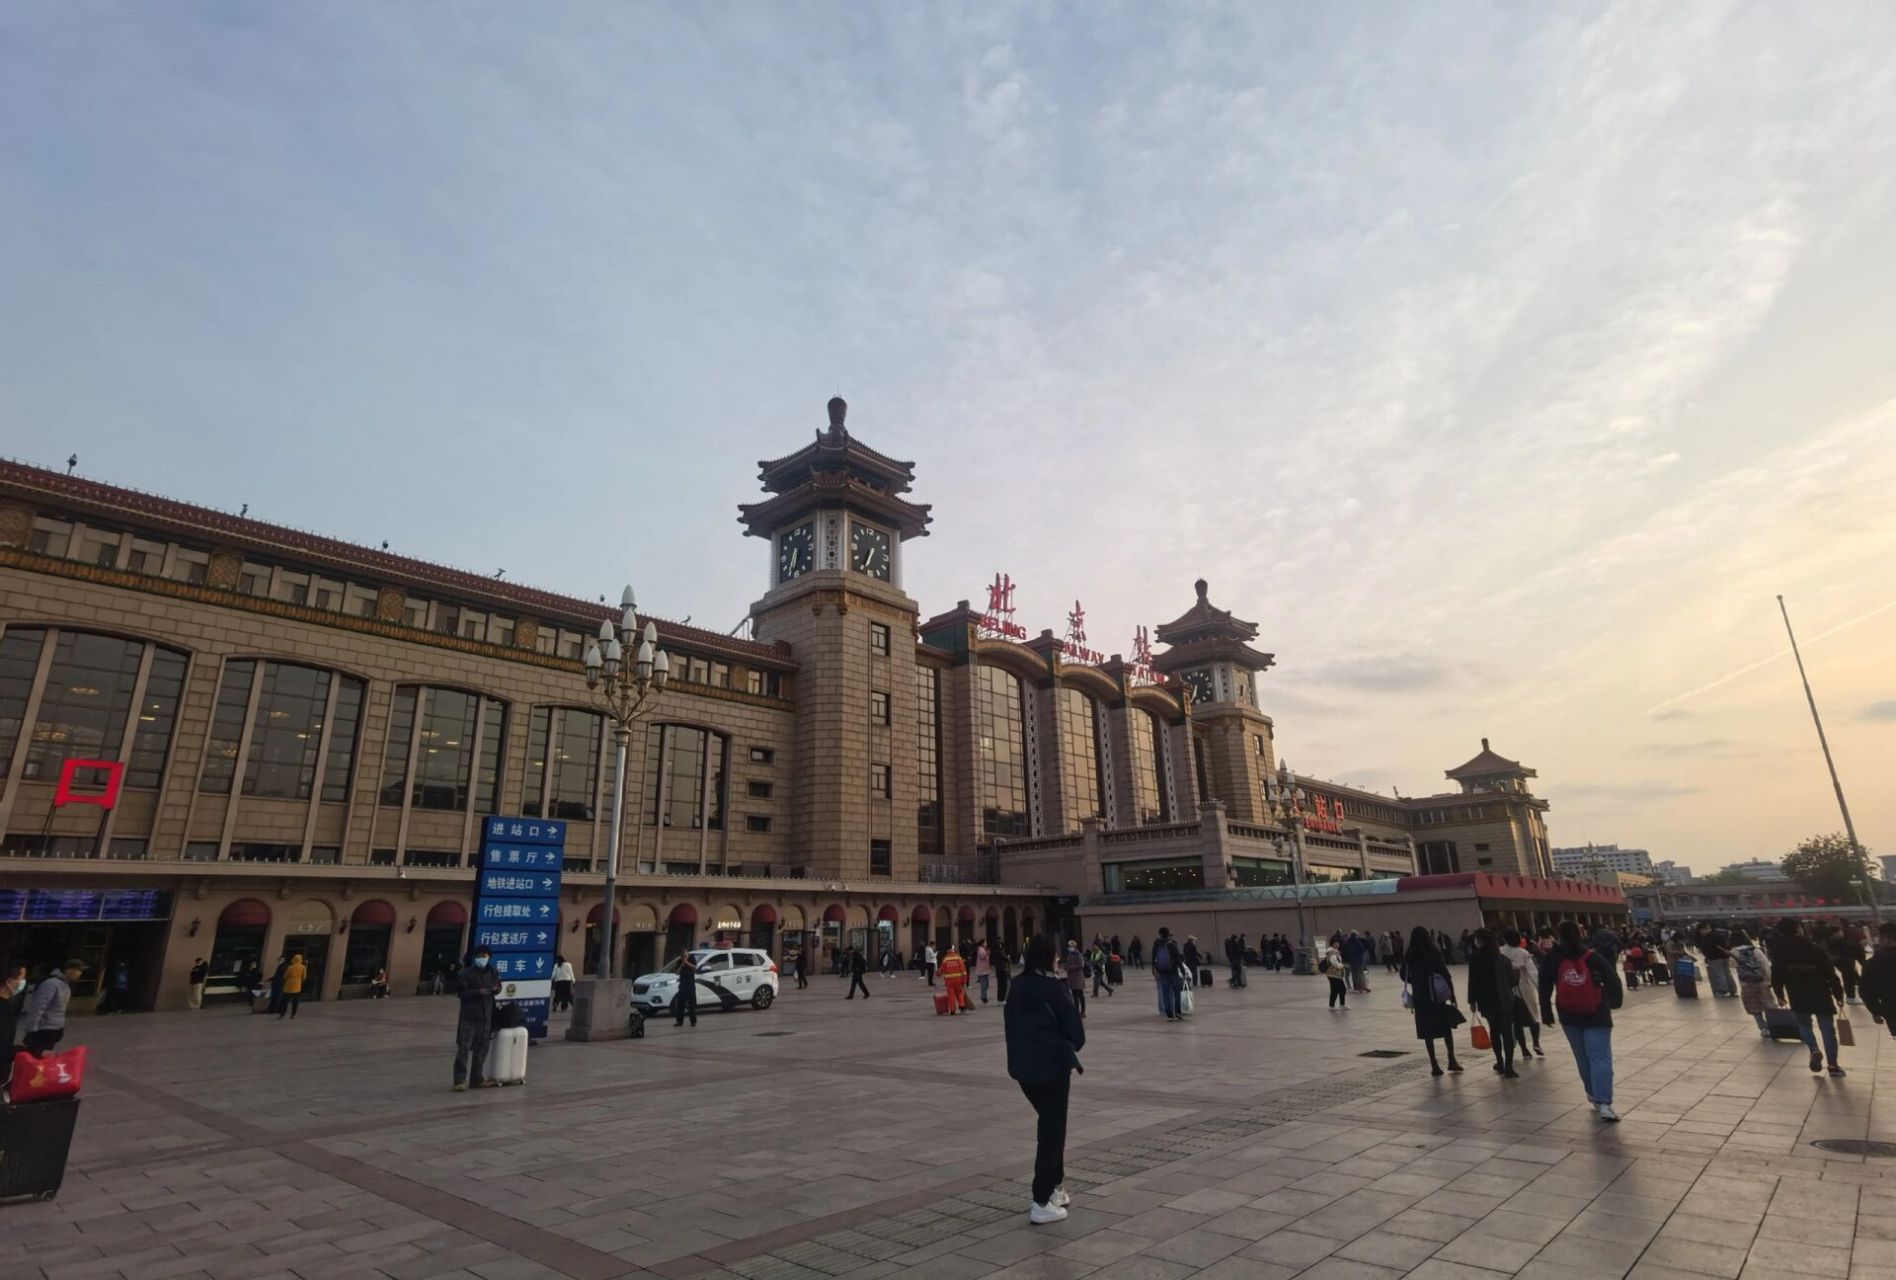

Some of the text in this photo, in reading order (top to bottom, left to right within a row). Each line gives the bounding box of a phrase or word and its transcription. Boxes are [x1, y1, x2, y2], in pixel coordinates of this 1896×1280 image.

[980, 616, 1027, 641] BEIJING
[1061, 641, 1105, 665] AILWAY
[492, 822, 540, 837] 进站口
[490, 848, 538, 864] 售票厅
[487, 876, 534, 890] 地铁进站口
[483, 904, 531, 917] 行包提取处
[481, 931, 529, 945] 行包发送厅
